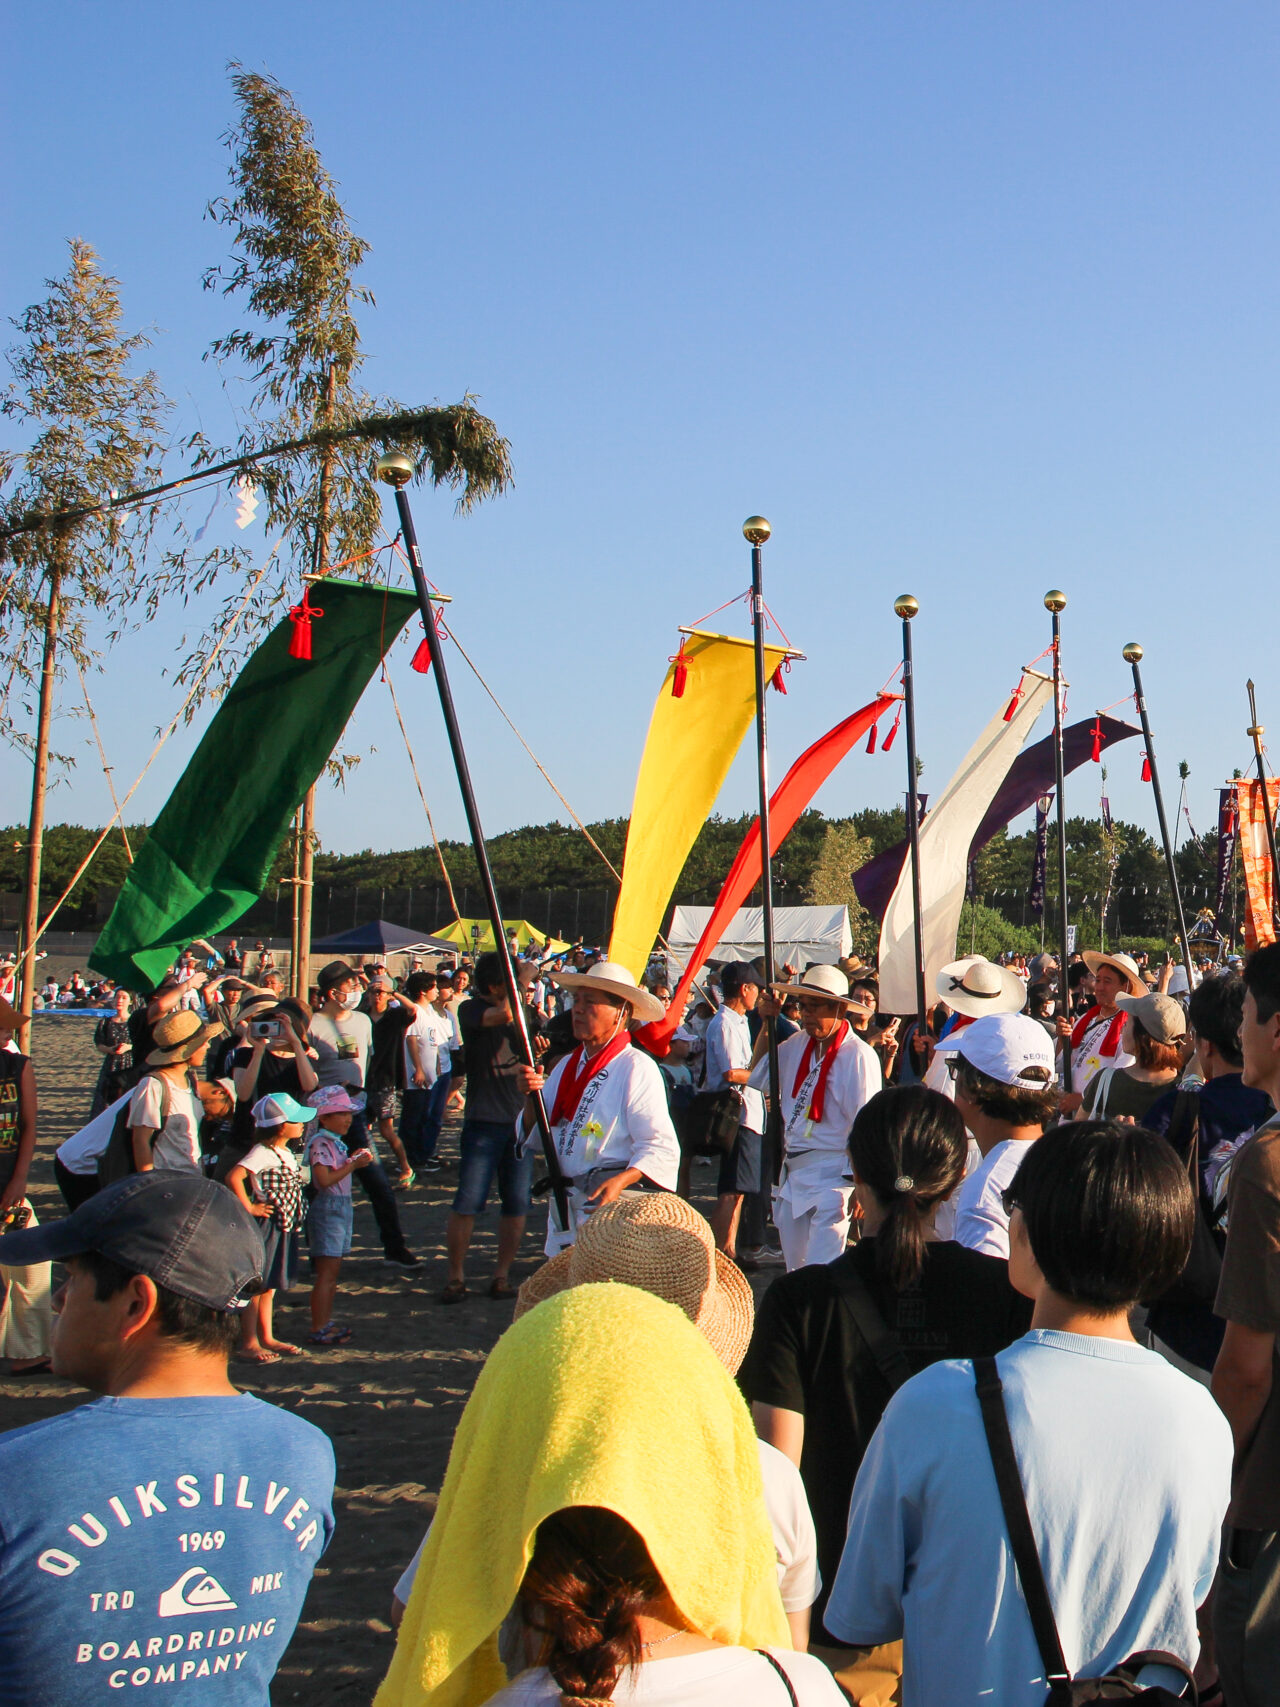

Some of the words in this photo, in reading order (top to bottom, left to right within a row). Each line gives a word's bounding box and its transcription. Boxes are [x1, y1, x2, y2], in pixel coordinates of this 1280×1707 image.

[1023, 1053, 1048, 1061] SEOUL
[37, 1473, 318, 1577] QUIKSILVER
[178, 1530, 226, 1553] 1969
[90, 1590, 135, 1612] TRD
[251, 1571, 284, 1595] MRK
[76, 1618, 278, 1663] BOARDRIDING
[108, 1651, 248, 1688] COMPANY
